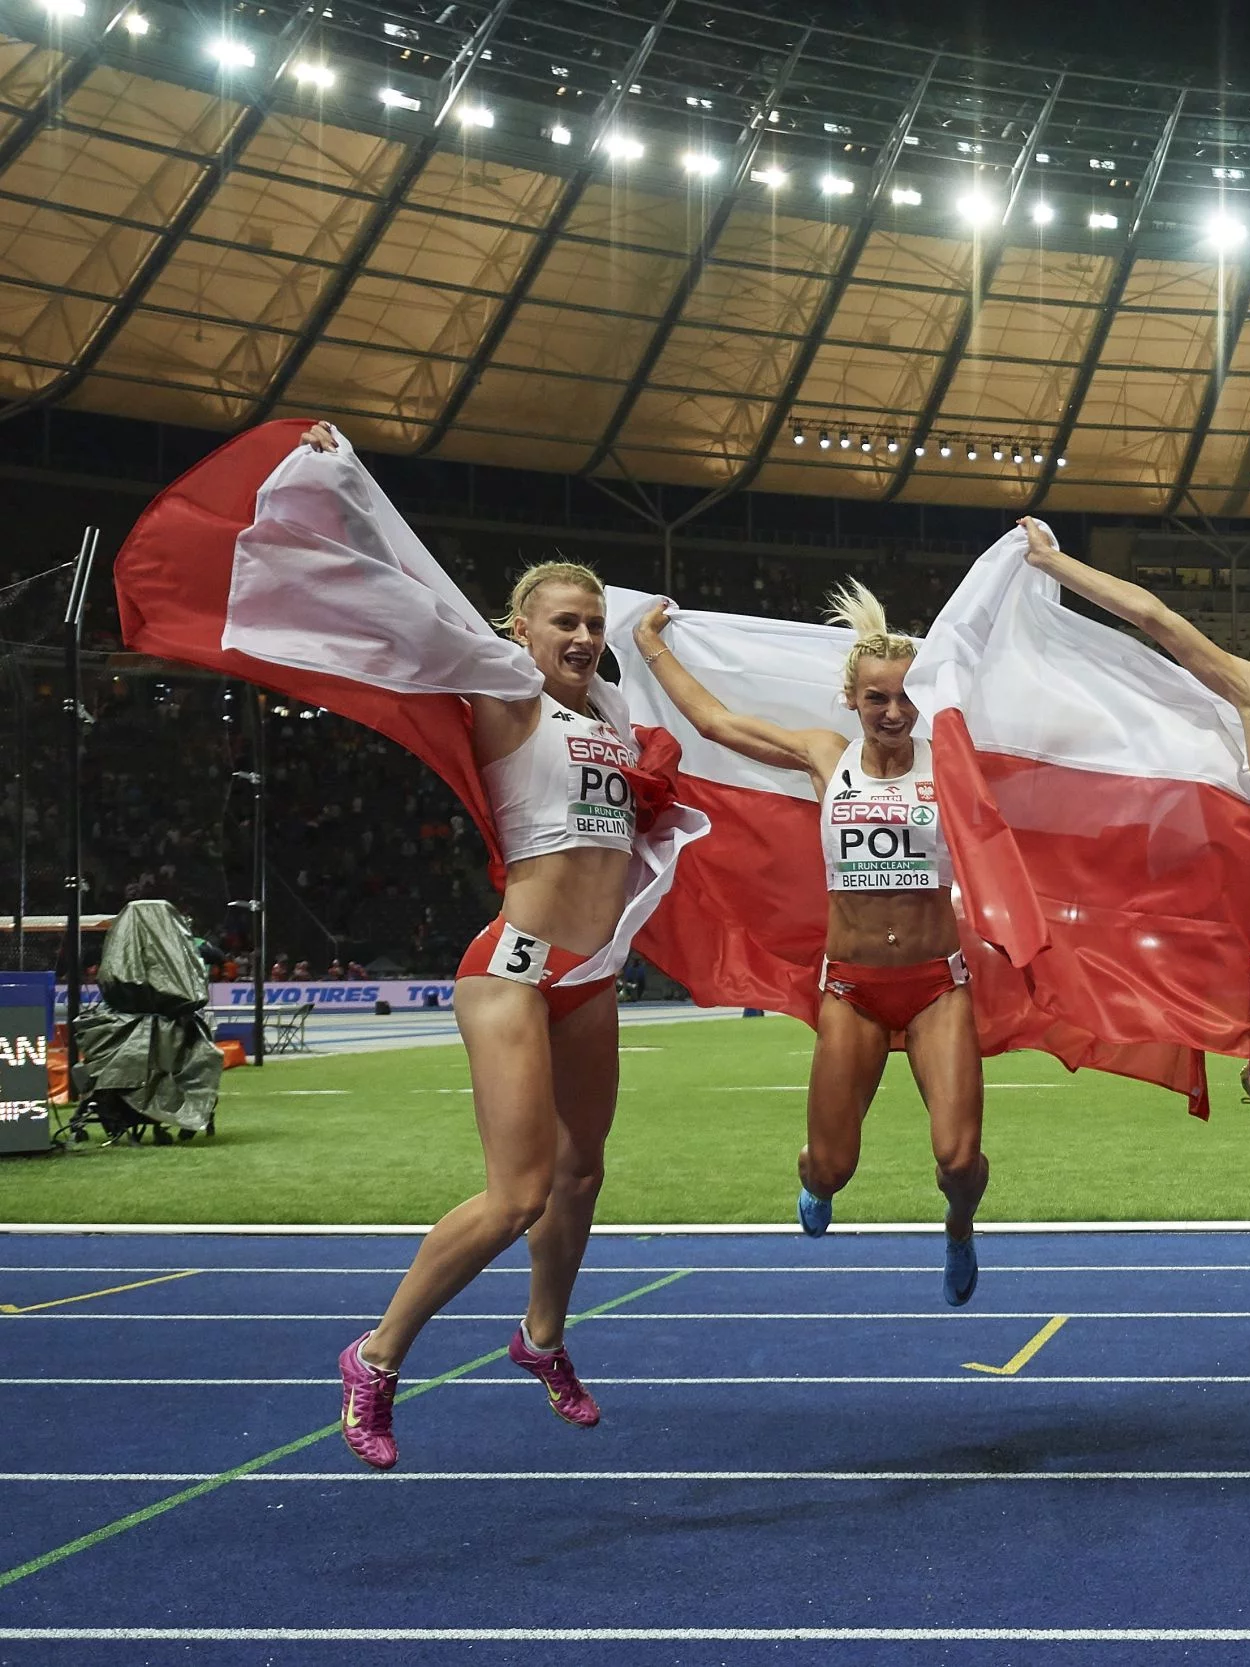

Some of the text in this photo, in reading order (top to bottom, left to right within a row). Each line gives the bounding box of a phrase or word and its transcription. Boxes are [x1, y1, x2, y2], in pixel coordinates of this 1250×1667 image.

[570, 740, 632, 768] SPAR
[594, 807, 612, 817] RUN
[833, 804, 907, 821] SPAR
[576, 817, 626, 835] BERLIN
[840, 827, 927, 859] POL
[857, 862, 878, 870] RUN
[842, 873, 929, 887] BERLIN 2018
[506, 936, 536, 973] 5
[305, 986, 380, 1001] TIRES
